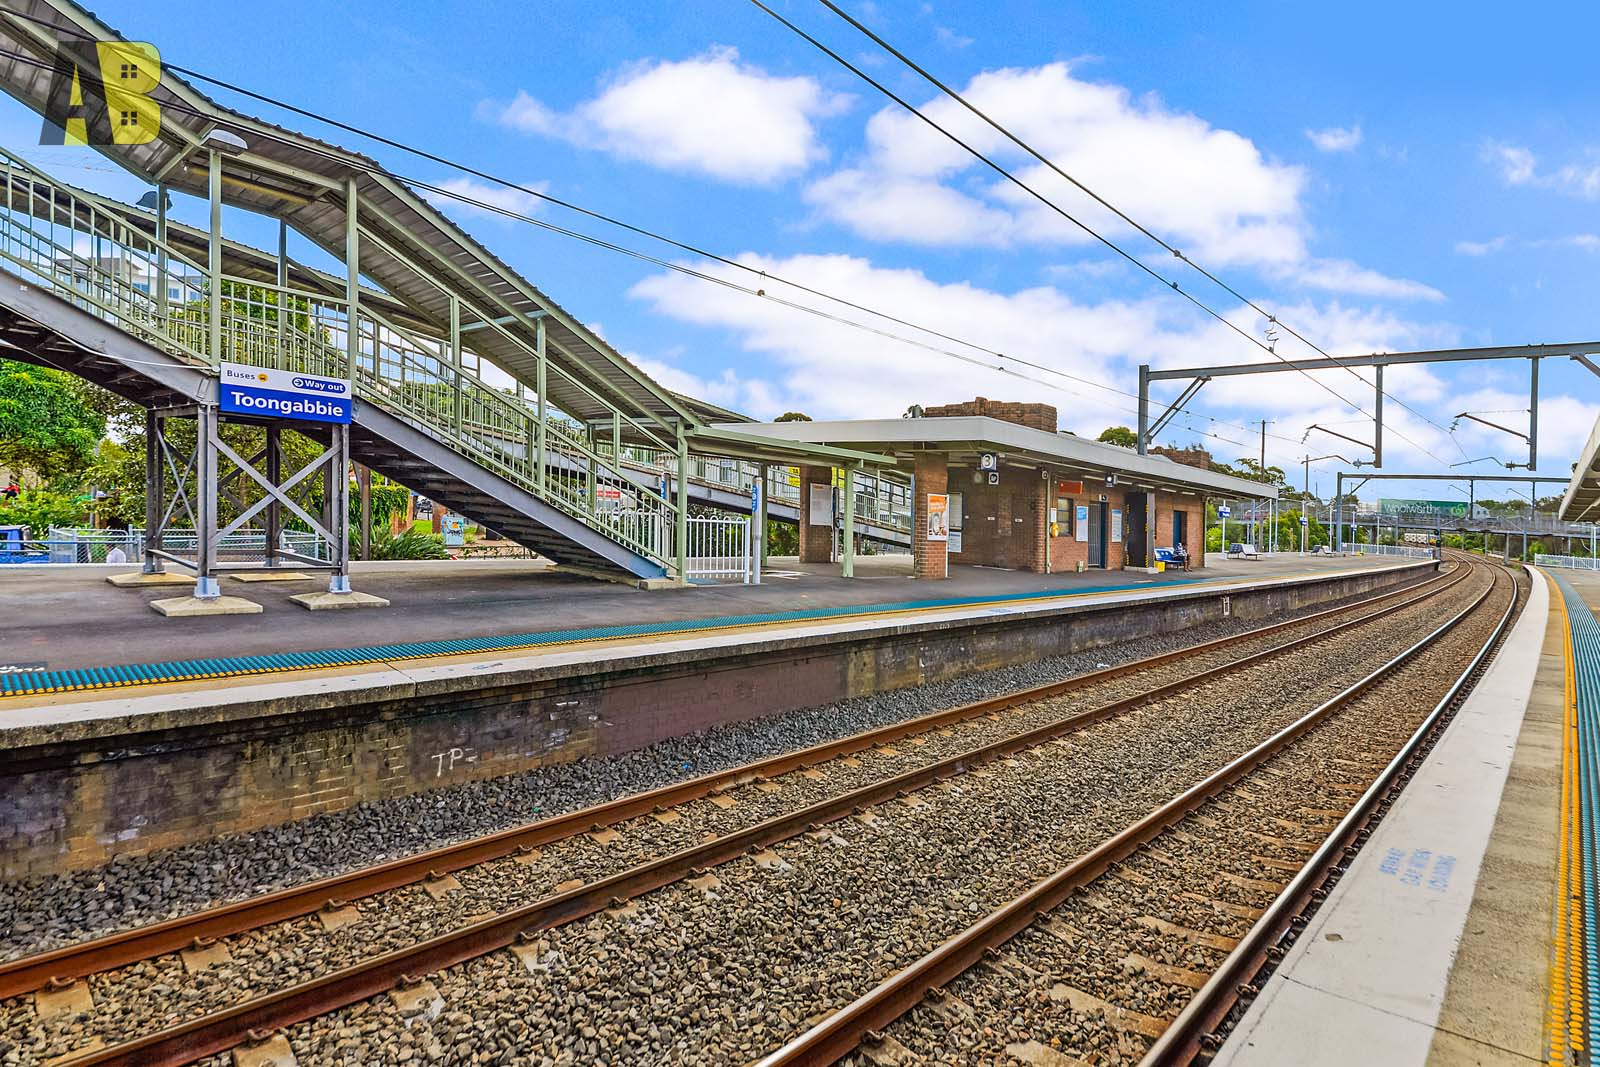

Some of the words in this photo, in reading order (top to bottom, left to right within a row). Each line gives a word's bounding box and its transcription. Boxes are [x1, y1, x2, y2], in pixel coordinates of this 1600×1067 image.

[226, 370, 256, 380] Buses
[304, 379, 325, 390] Way
[328, 383, 344, 391] out
[231, 392, 344, 416] Toongabbie
[984, 456, 990, 466] 3
[1384, 503, 1440, 514] Woolworths
